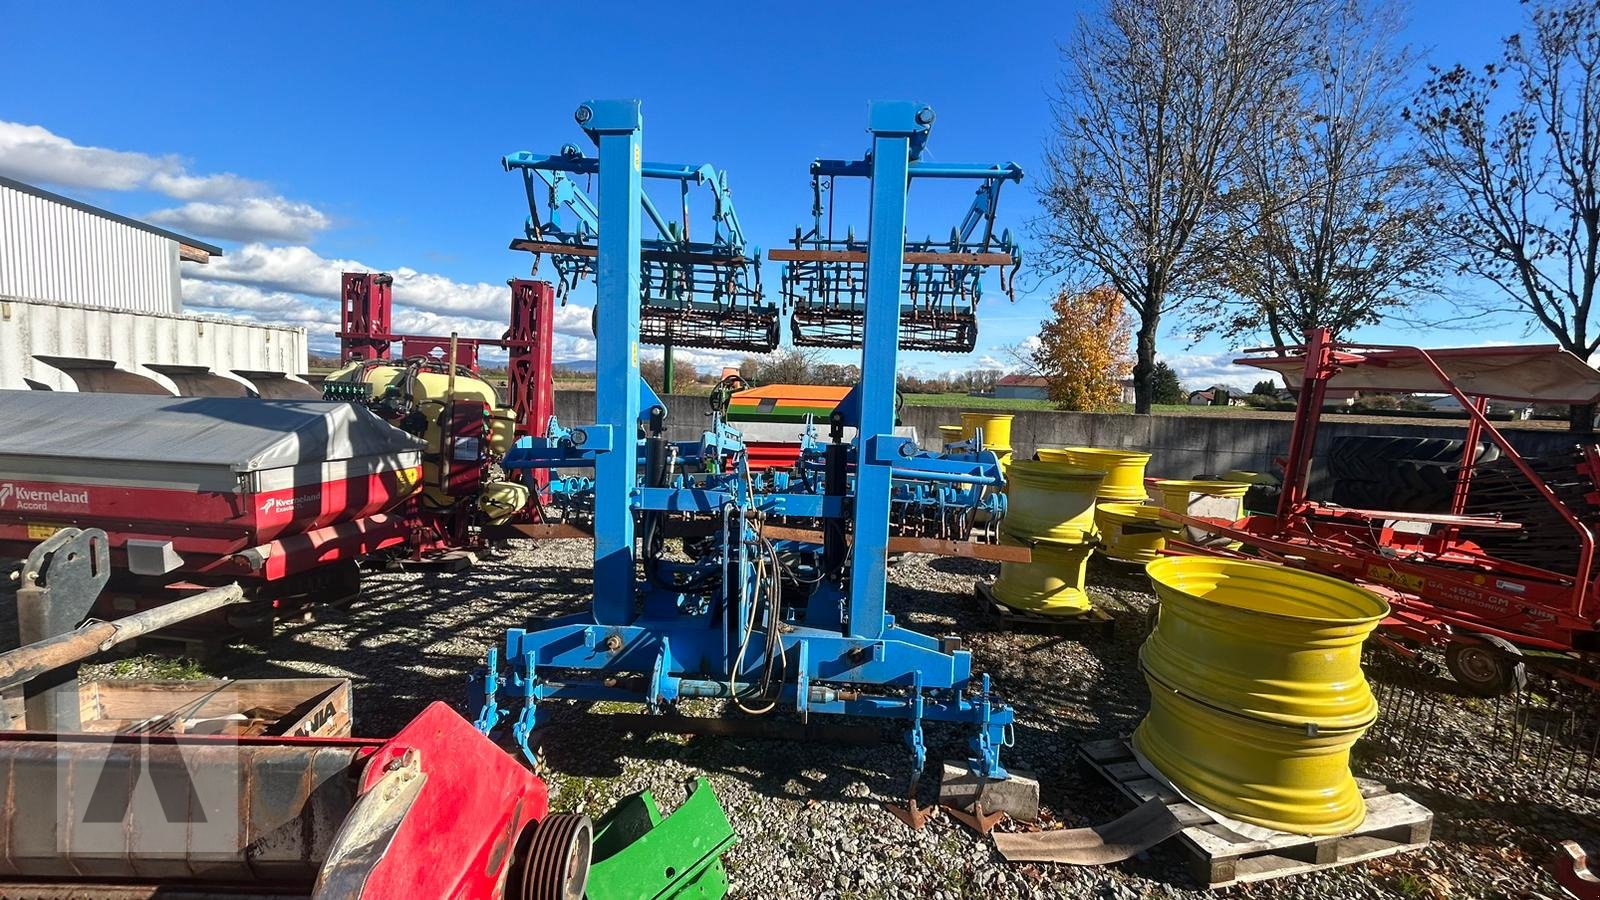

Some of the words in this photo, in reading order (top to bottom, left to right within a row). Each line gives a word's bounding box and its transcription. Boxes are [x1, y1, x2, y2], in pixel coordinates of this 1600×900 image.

[15, 486, 89, 504] Kverneland
[275, 491, 321, 507] Kverneland
[16, 500, 48, 510] Accord
[1450, 586, 1483, 599] 4521
[1488, 595, 1509, 607] GM
